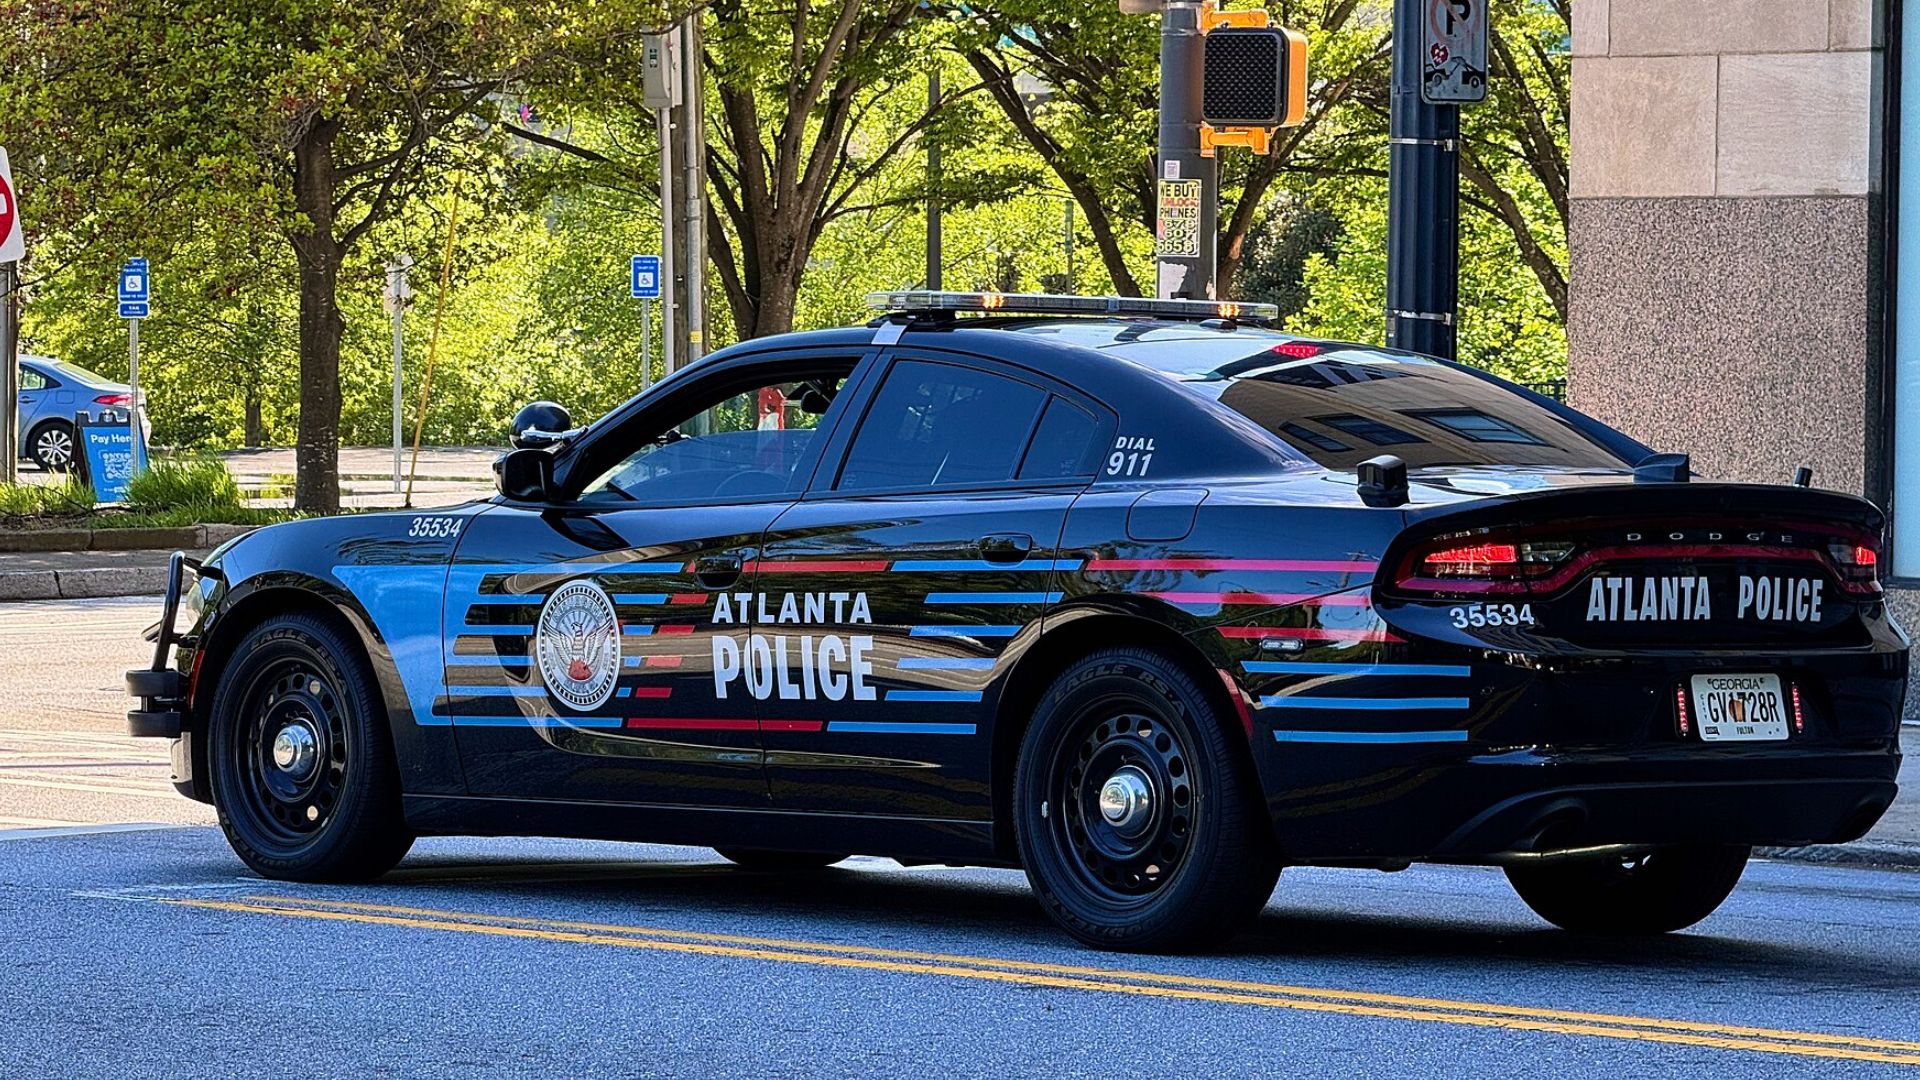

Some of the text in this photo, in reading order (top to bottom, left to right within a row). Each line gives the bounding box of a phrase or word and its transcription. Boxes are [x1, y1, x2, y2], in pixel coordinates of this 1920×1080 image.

[1174, 184, 1197, 197] BUY
[90, 434, 132, 445] Pay Her
[1115, 436, 1155, 451] DIAL
[1107, 451, 1153, 477] 911
[408, 517, 464, 538] 35534
[1626, 532, 1793, 543] DODGE
[711, 592, 873, 624] ATLANTA
[1586, 575, 1824, 622] ATLANTA POLICE
[1449, 603, 1535, 629] 35534
[711, 634, 877, 701] POLICE
[1054, 663, 1128, 704] EAGLE
[1711, 678, 1761, 690] GEORGIA
[1707, 691, 1780, 723] GV1728R
[1736, 726, 1755, 735] FULTON
